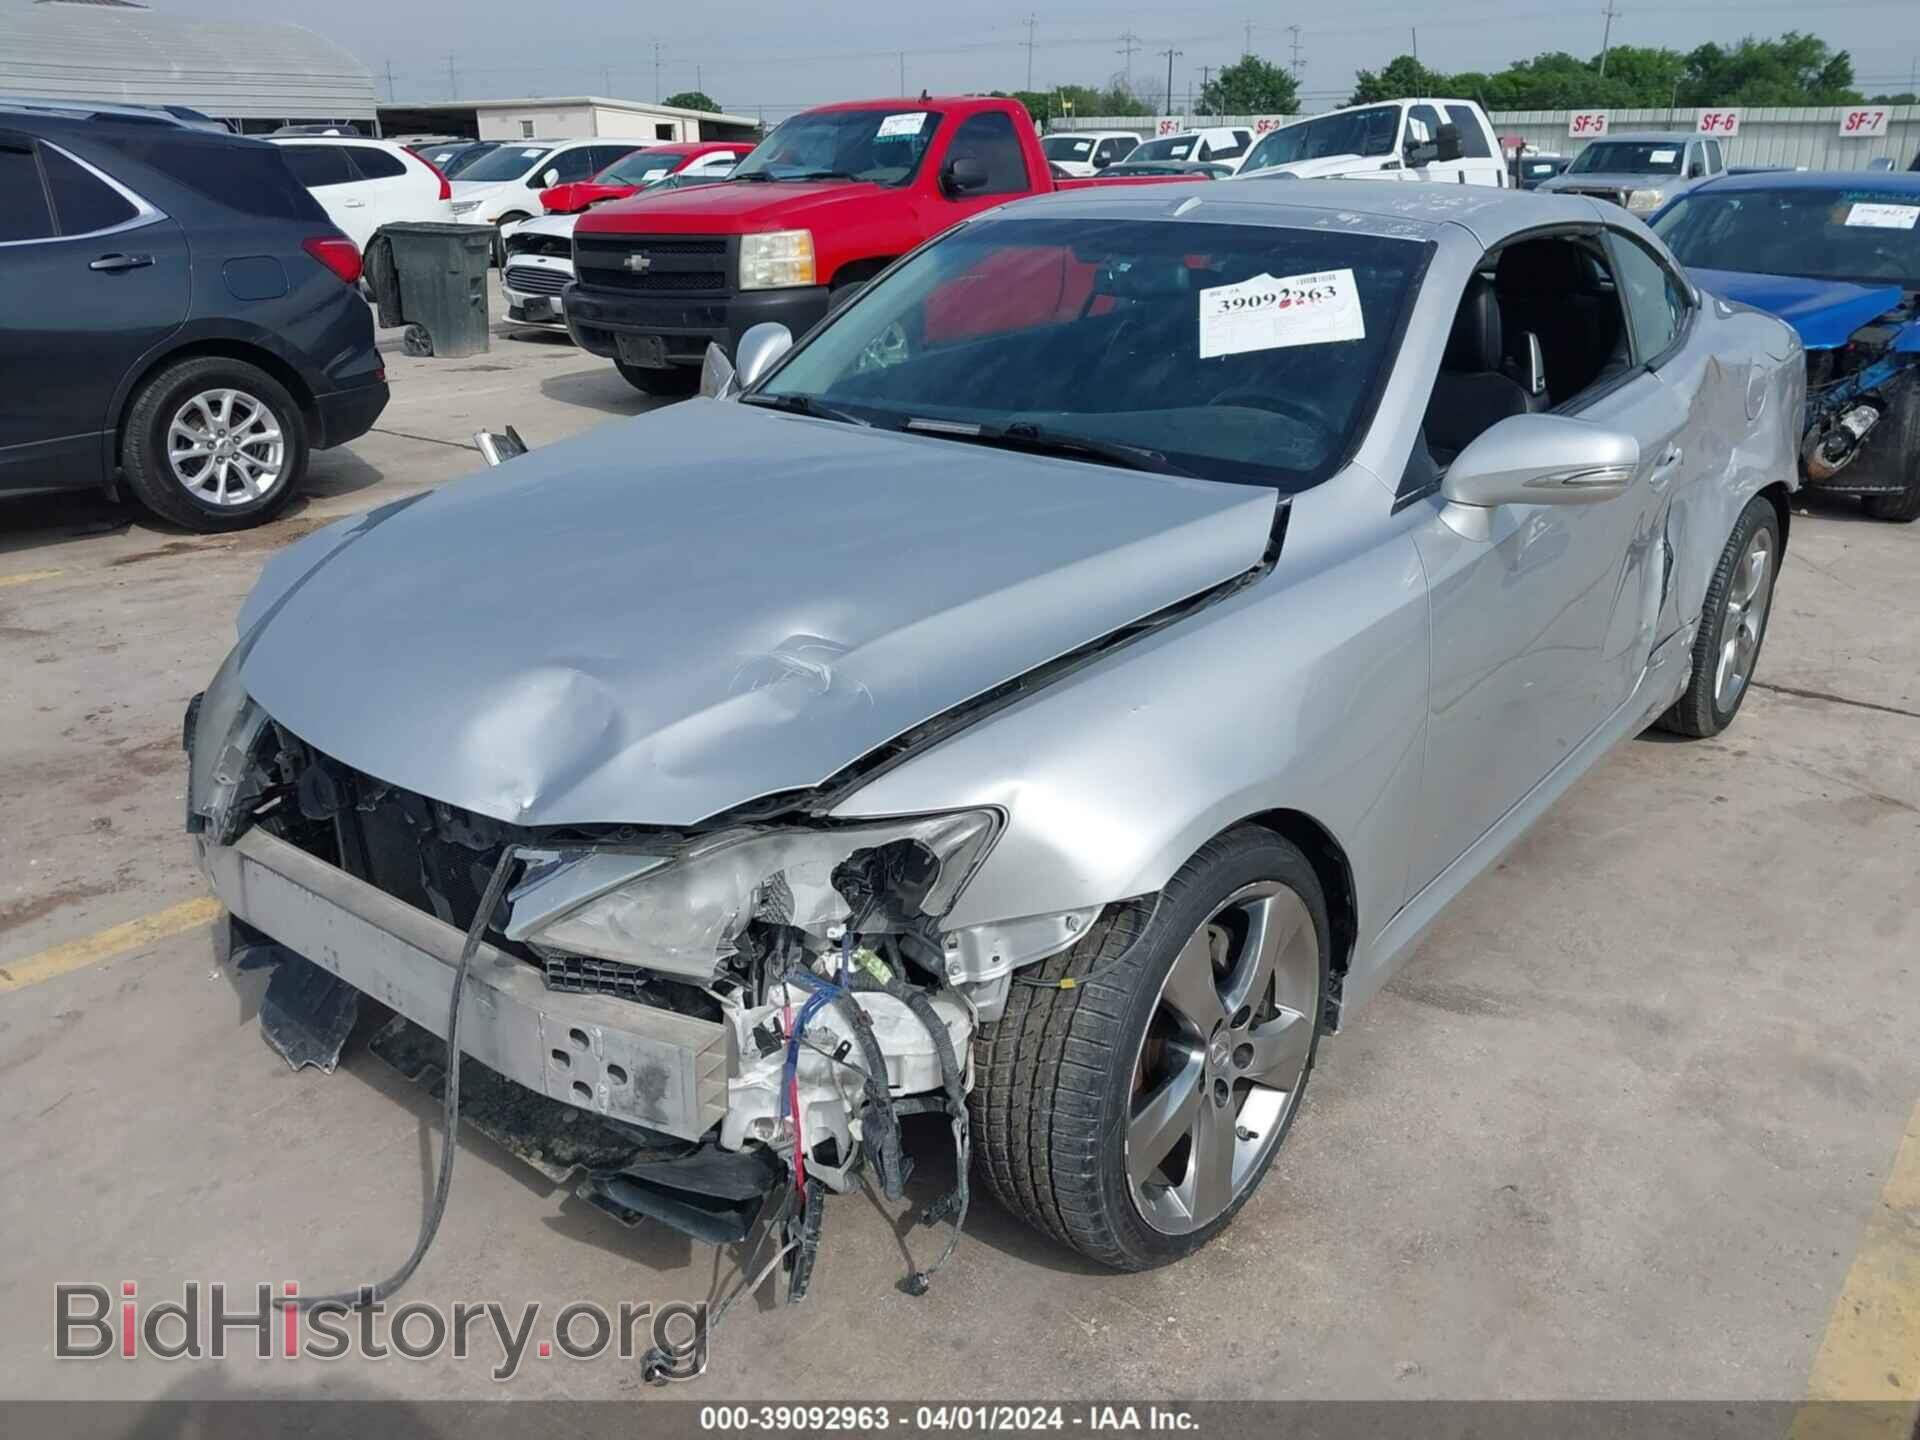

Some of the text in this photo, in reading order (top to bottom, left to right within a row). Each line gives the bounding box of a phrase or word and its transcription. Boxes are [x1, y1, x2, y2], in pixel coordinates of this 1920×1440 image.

[1160, 120, 1180, 135] SF-1
[1573, 115, 1604, 132] SF-5
[1701, 113, 1736, 131] SF-6
[1846, 112, 1883, 131] SF-7
